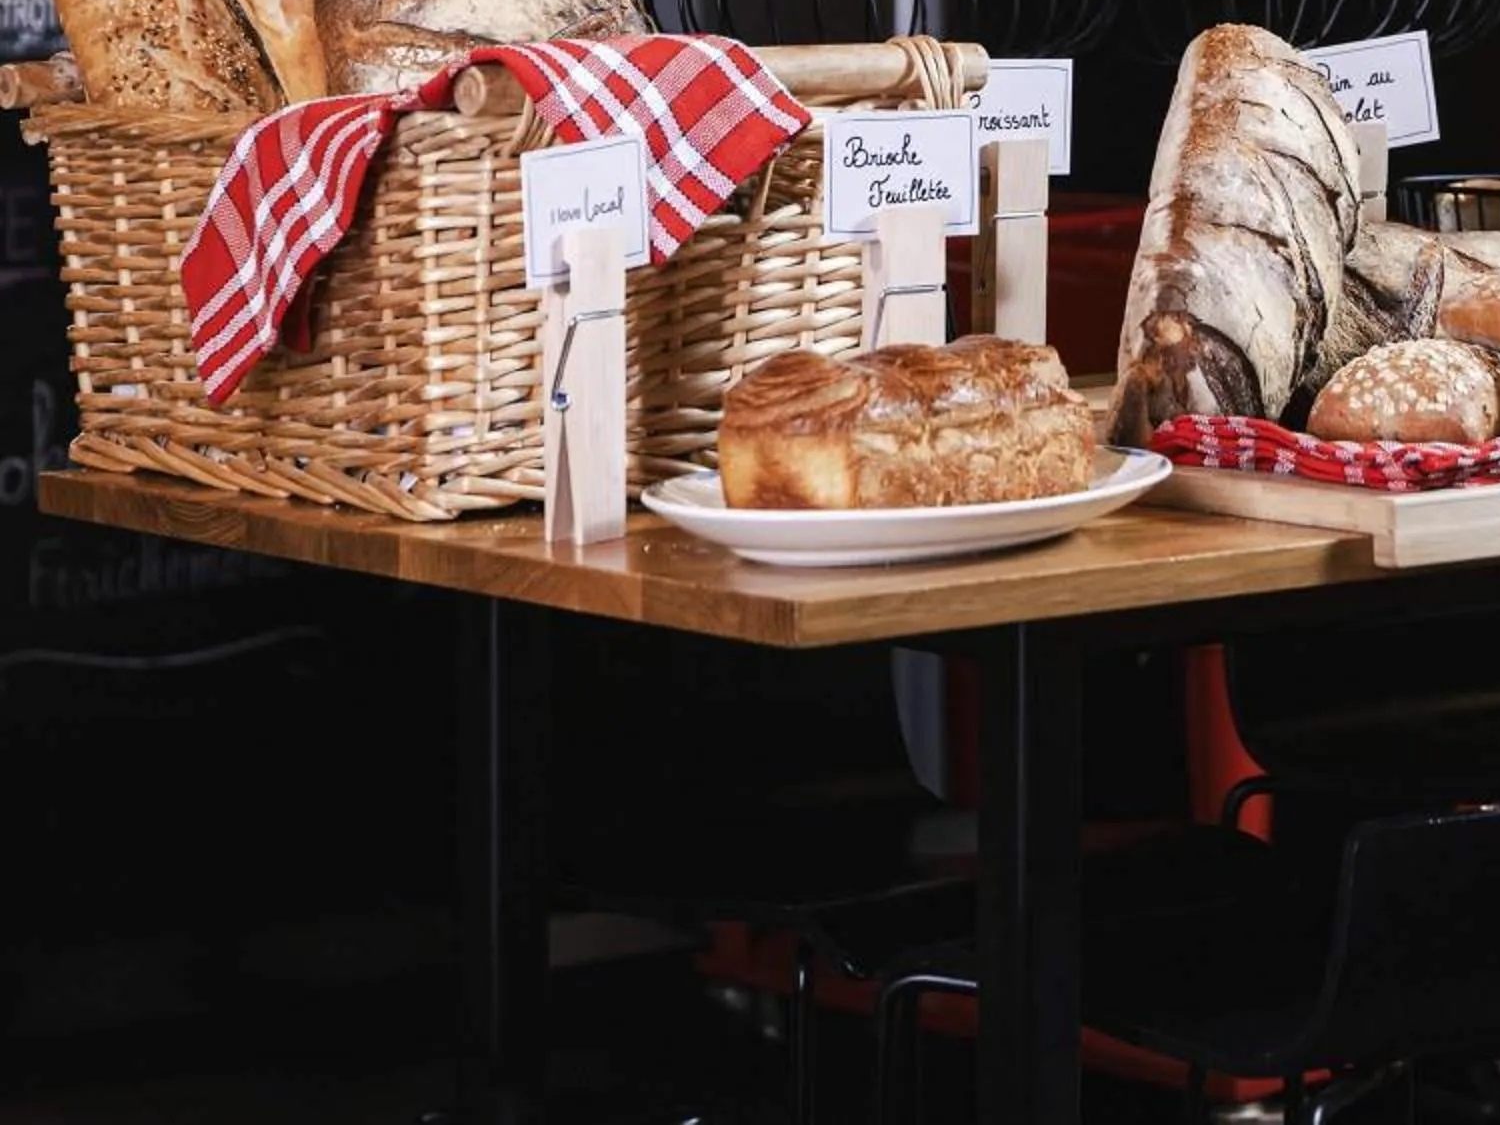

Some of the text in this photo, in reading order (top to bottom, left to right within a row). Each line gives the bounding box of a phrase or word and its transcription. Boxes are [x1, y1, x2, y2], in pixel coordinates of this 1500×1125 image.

[1316, 62, 1396, 94] in au
[1343, 96, 1386, 124] olat
[843, 133, 923, 169] Brioche
[867, 174, 952, 209] Feuilletée
